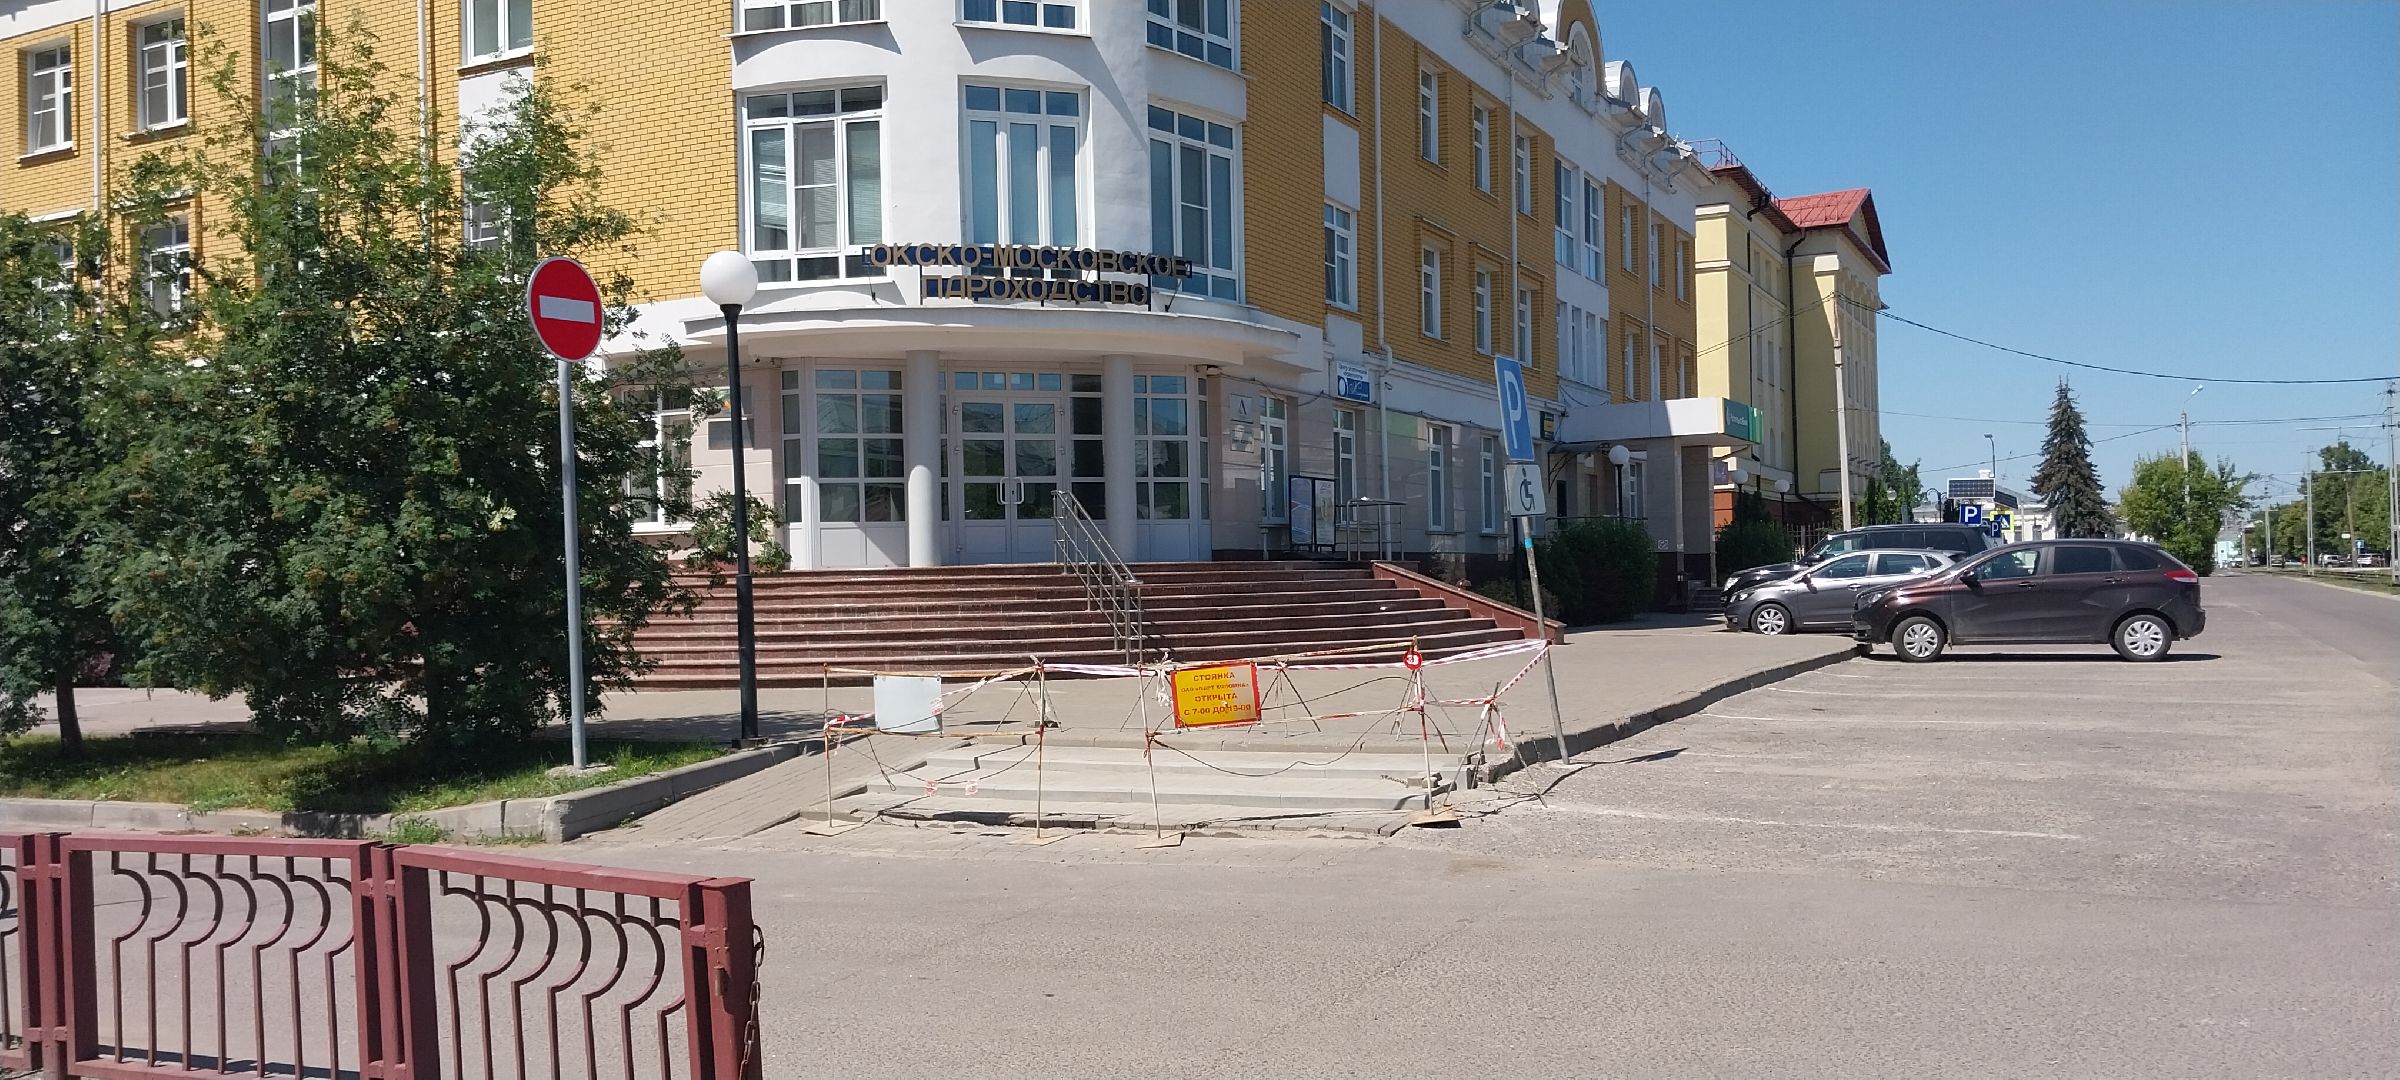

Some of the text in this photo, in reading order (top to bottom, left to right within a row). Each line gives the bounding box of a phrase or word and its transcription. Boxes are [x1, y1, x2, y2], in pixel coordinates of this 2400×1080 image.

[870, 243, 1188, 279] ОКСКО-МОСКОВСКОЕ
[921, 274, 1149, 306] ПАРОХОДСТВО
[1964, 506, 1978, 523] P
[1193, 672, 1235, 681] СТОЯНКА
[1195, 692, 1238, 702] ОТКРЫТА
